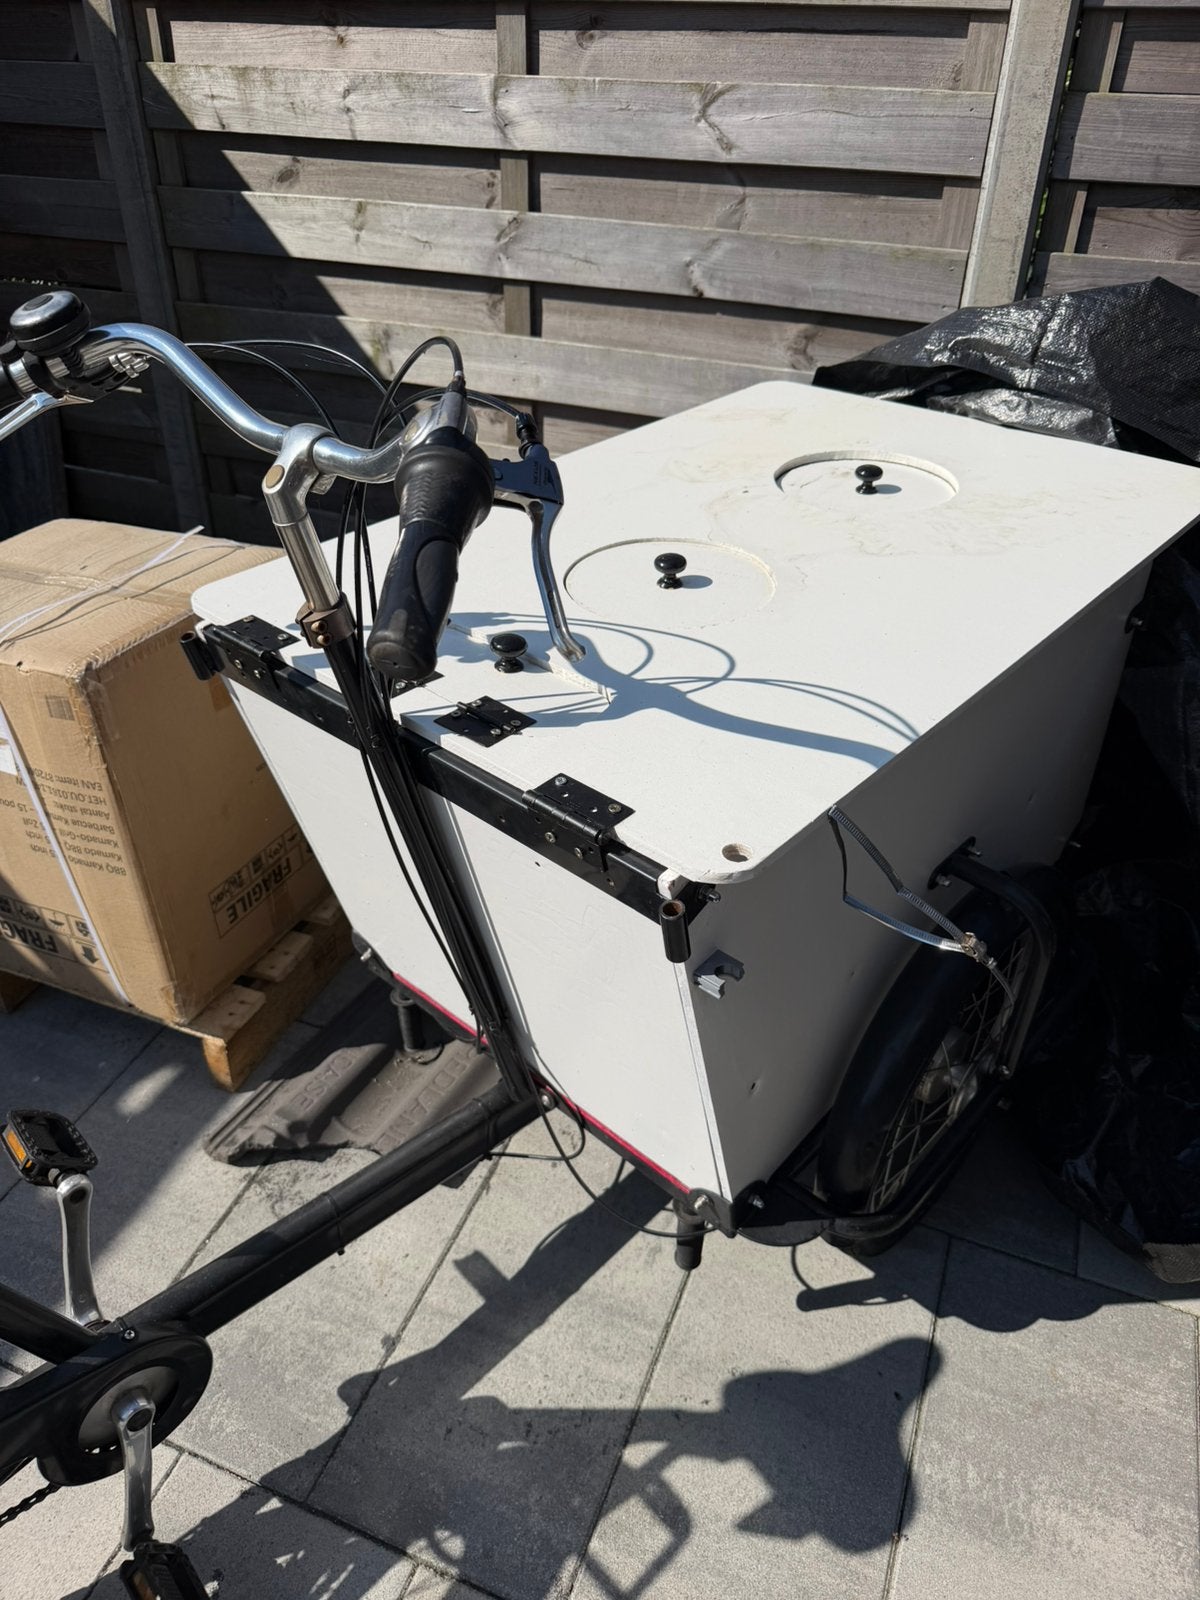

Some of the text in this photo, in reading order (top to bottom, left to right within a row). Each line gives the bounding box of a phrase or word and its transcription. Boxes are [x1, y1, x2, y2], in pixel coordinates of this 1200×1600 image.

[80, 779, 103, 792] EAN
[17, 802, 28, 813] 15
[80, 808, 110, 821] Aantal
[22, 817, 39, 829] Zoll
[71, 818, 115, 835] Barbecue
[25, 829, 43, 840] inch
[30, 843, 48, 855] inch
[64, 841, 82, 855] BBQ
[83, 847, 123, 863] Kamado
[67, 854, 104, 871] Kamado
[105, 862, 127, 876] BBQ
[226, 857, 292, 924] FRAGILE
